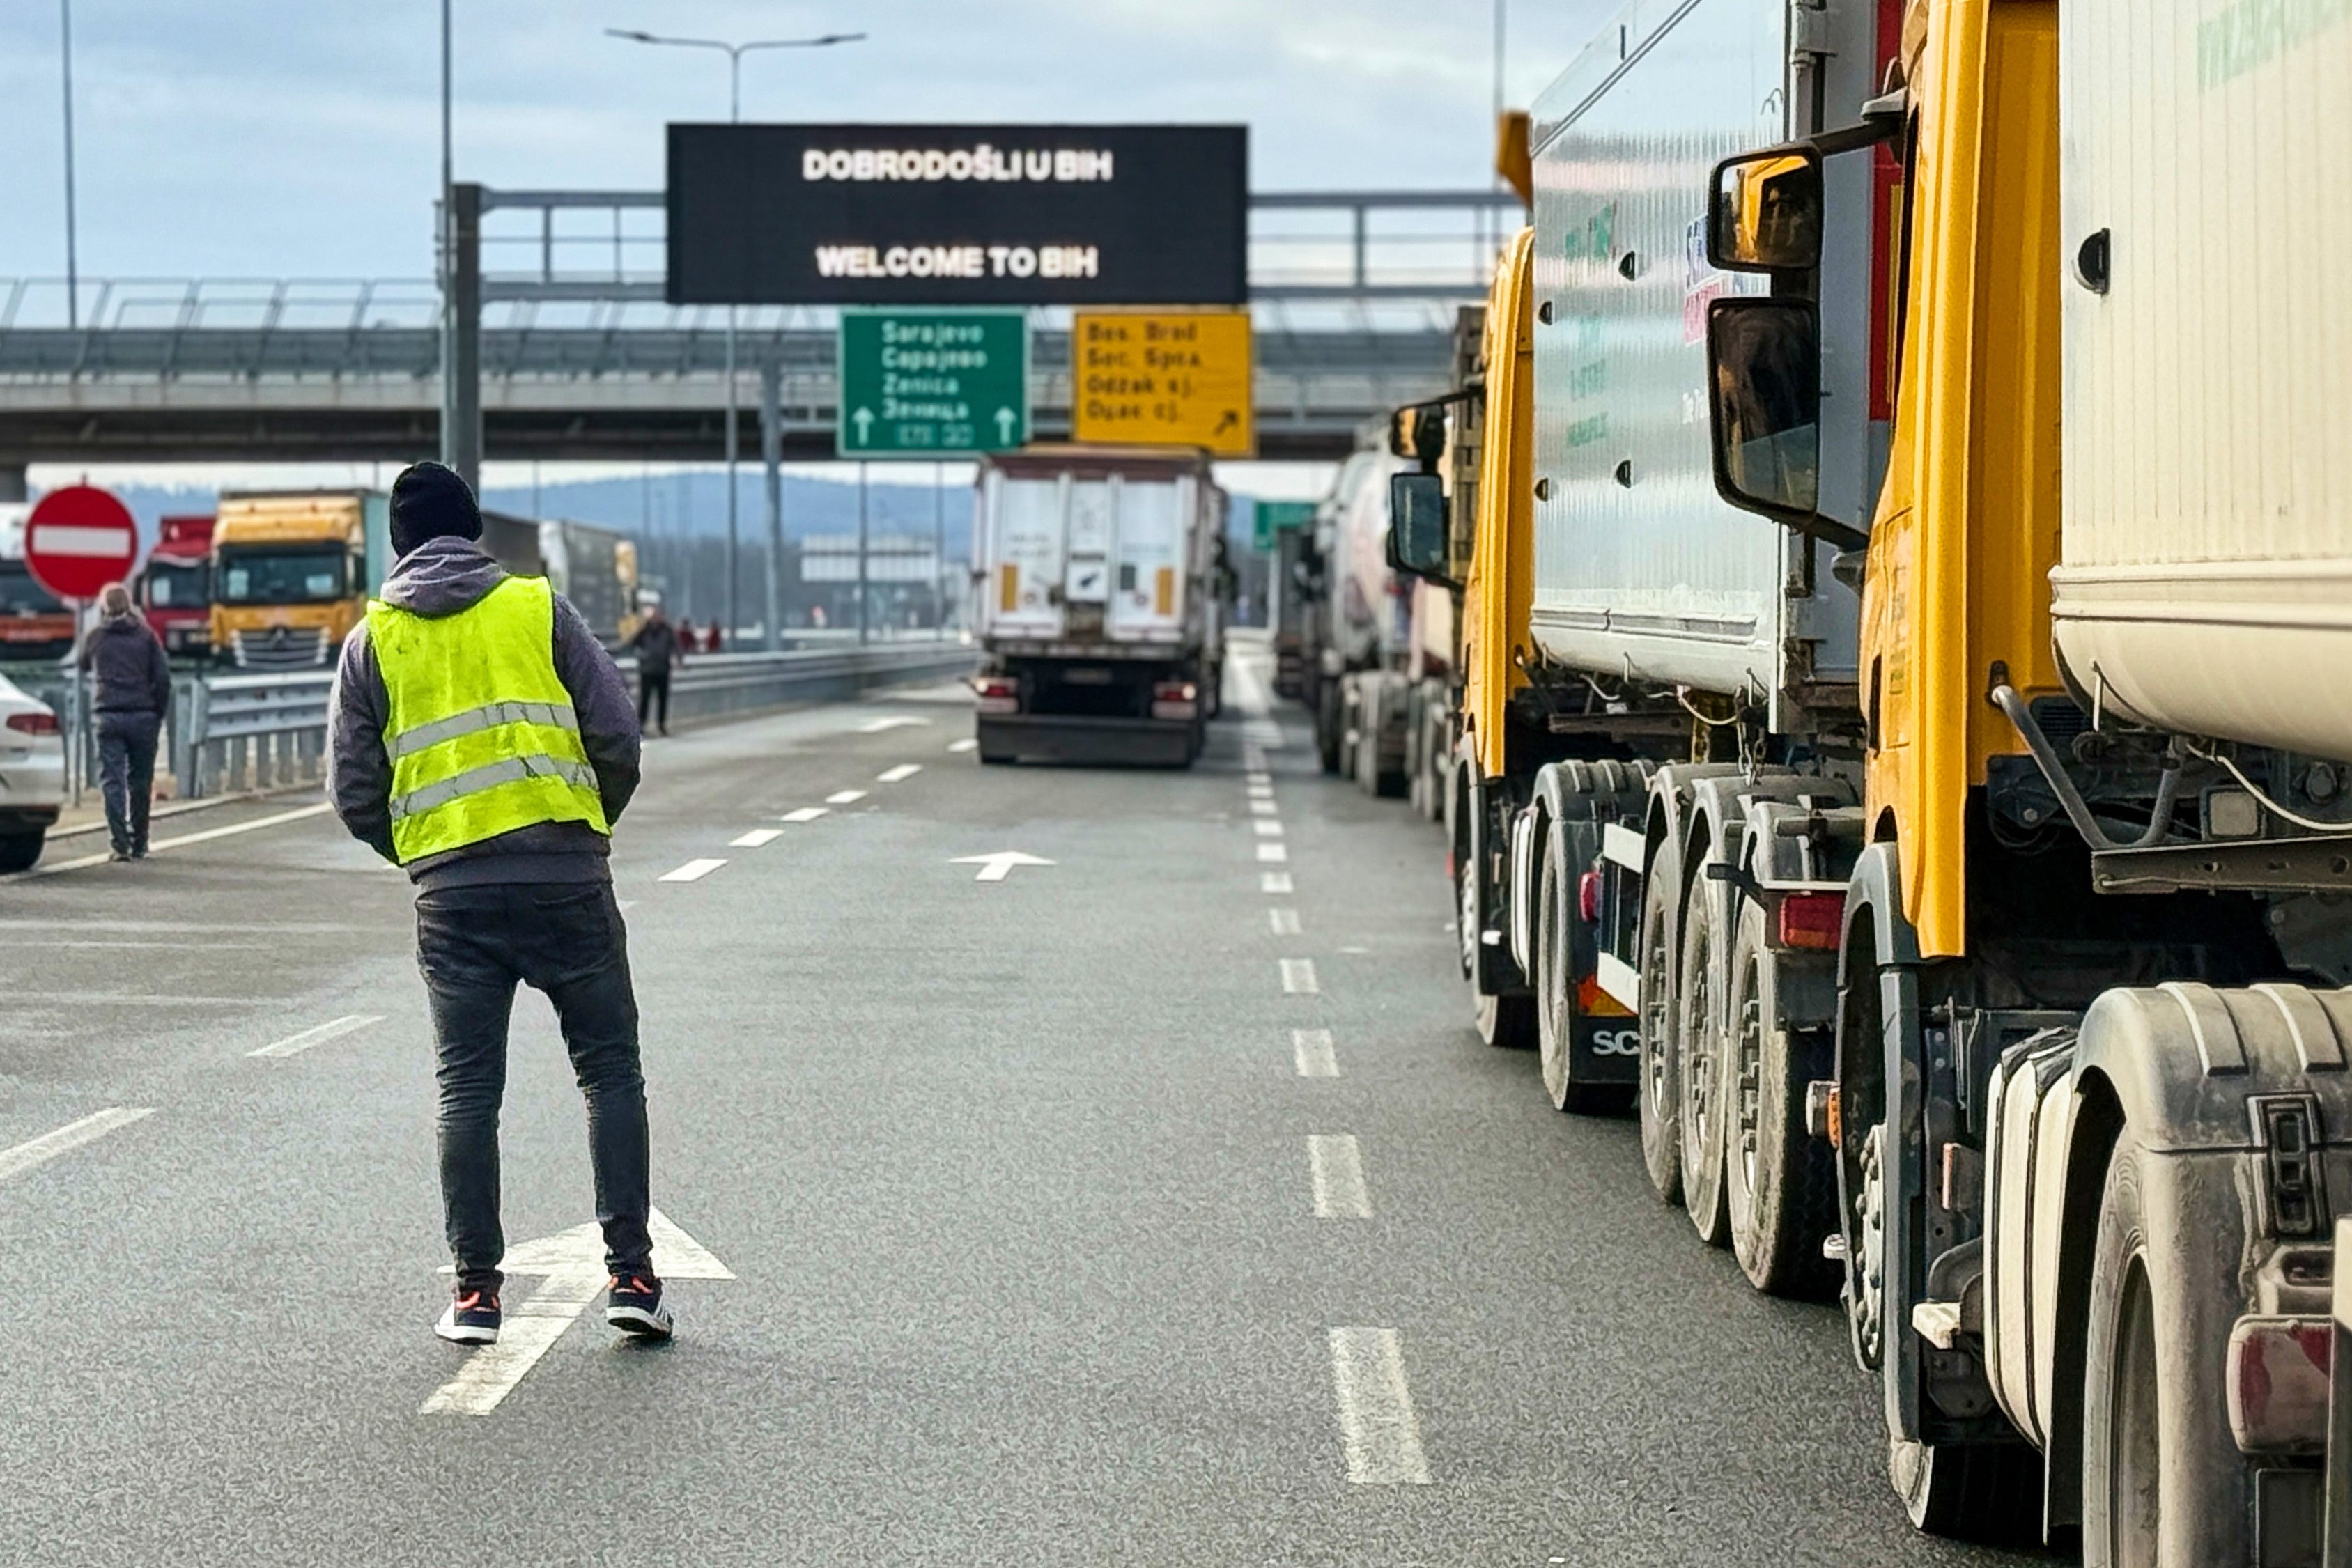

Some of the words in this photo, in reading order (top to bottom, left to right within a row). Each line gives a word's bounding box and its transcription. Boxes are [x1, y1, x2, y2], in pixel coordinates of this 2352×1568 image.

[802, 143, 1022, 181] DOBRODOŠLI
[1025, 149, 1051, 181] U
[1054, 149, 1113, 181] BIH
[816, 245, 984, 277] WELCOME
[987, 245, 1037, 277] TO
[1039, 245, 1099, 277] BIH
[881, 320, 984, 348] Sarajevo
[882, 372, 959, 395] Zenica
